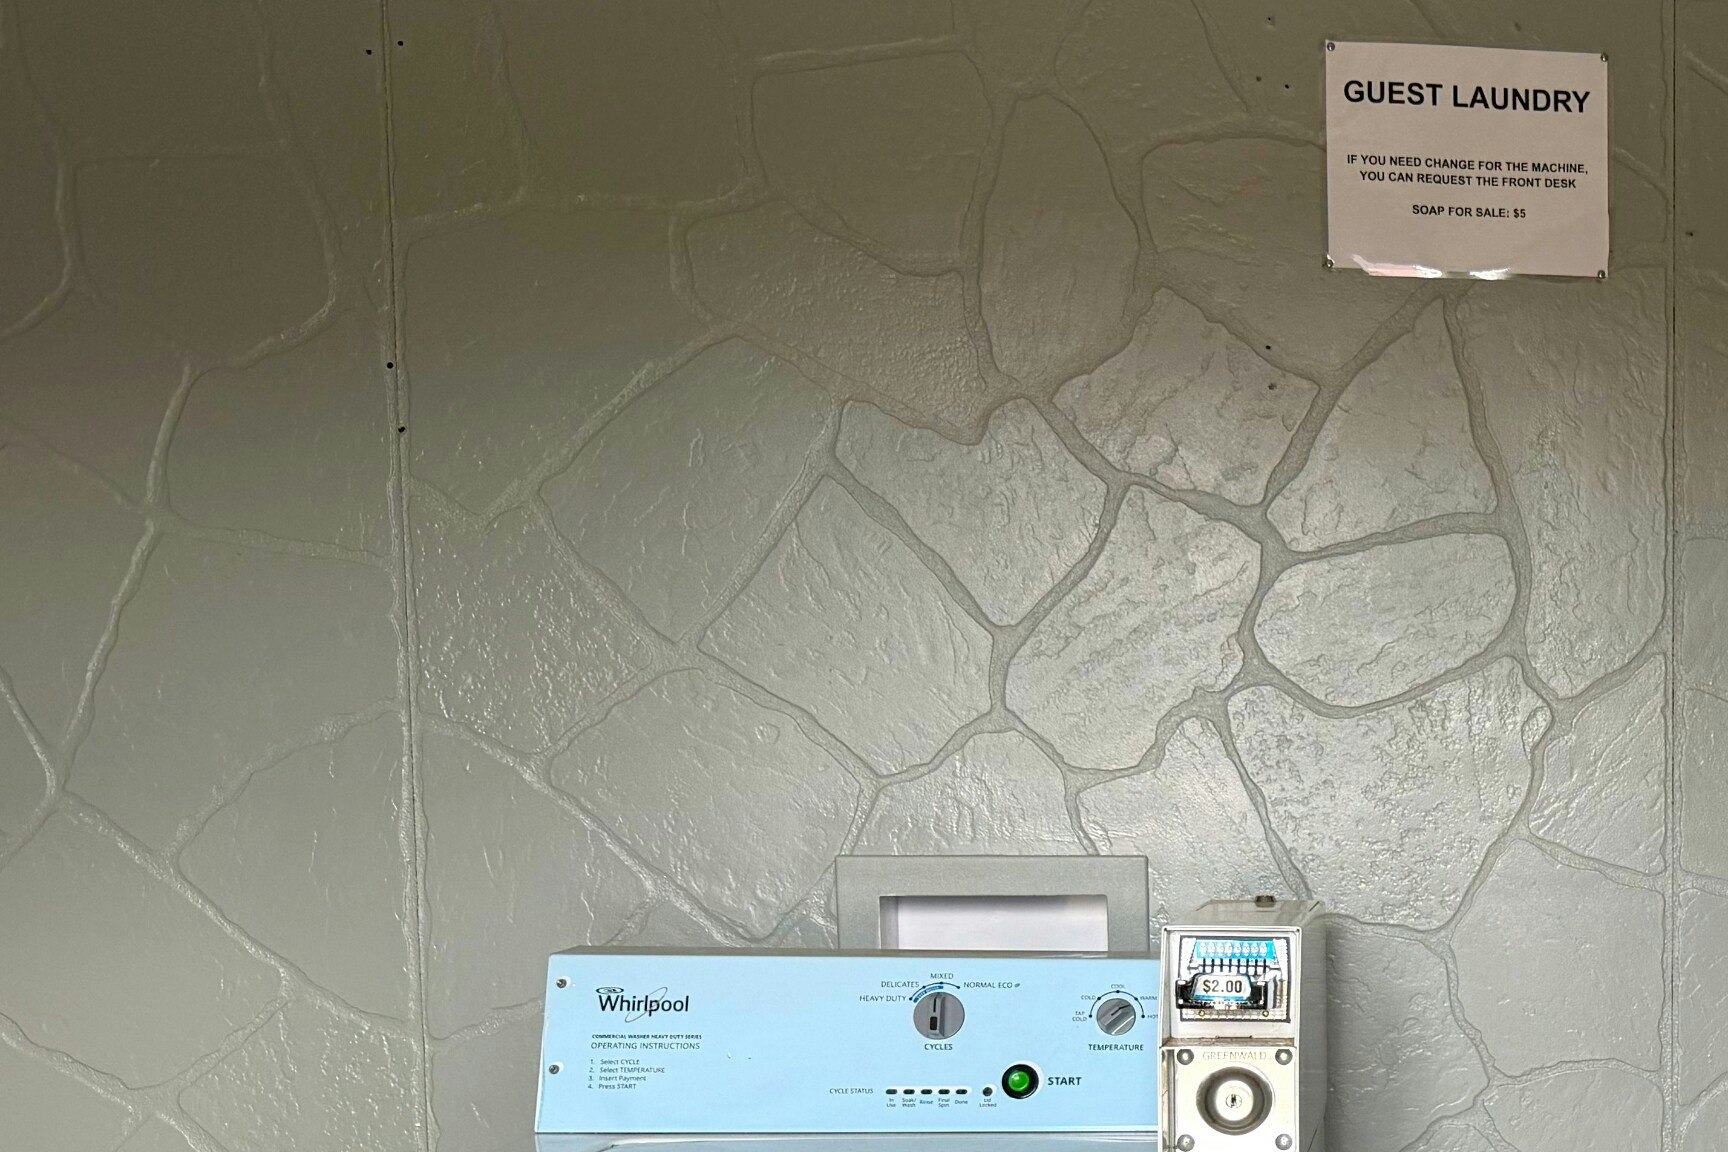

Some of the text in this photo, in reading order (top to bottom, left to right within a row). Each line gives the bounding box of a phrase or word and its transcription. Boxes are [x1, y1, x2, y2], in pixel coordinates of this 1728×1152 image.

[1343, 79, 1591, 113] GUEST LAUNDRY
[1347, 154, 1588, 175] IF YOU NEED CHANGE FOR THE MACHINE,
[1359, 170, 1577, 189] YOU CAN REQUEST THE FRONT DESK
[1412, 204, 1526, 219] SOAP FOR SALE: $5
[930, 972, 954, 980] MIXED
[963, 981, 1013, 989] NORMAL ECO
[1202, 979, 1243, 994] $2.00
[598, 994, 689, 1018] Whirlpool
[590, 1042, 701, 1050] OPERATING INSTRUCTIONS
[924, 1043, 954, 1051] CYCLES
[1088, 1043, 1145, 1051] TEMPERATURE
[618, 1075, 647, 1083] Payment
[1047, 1076, 1083, 1086] START
